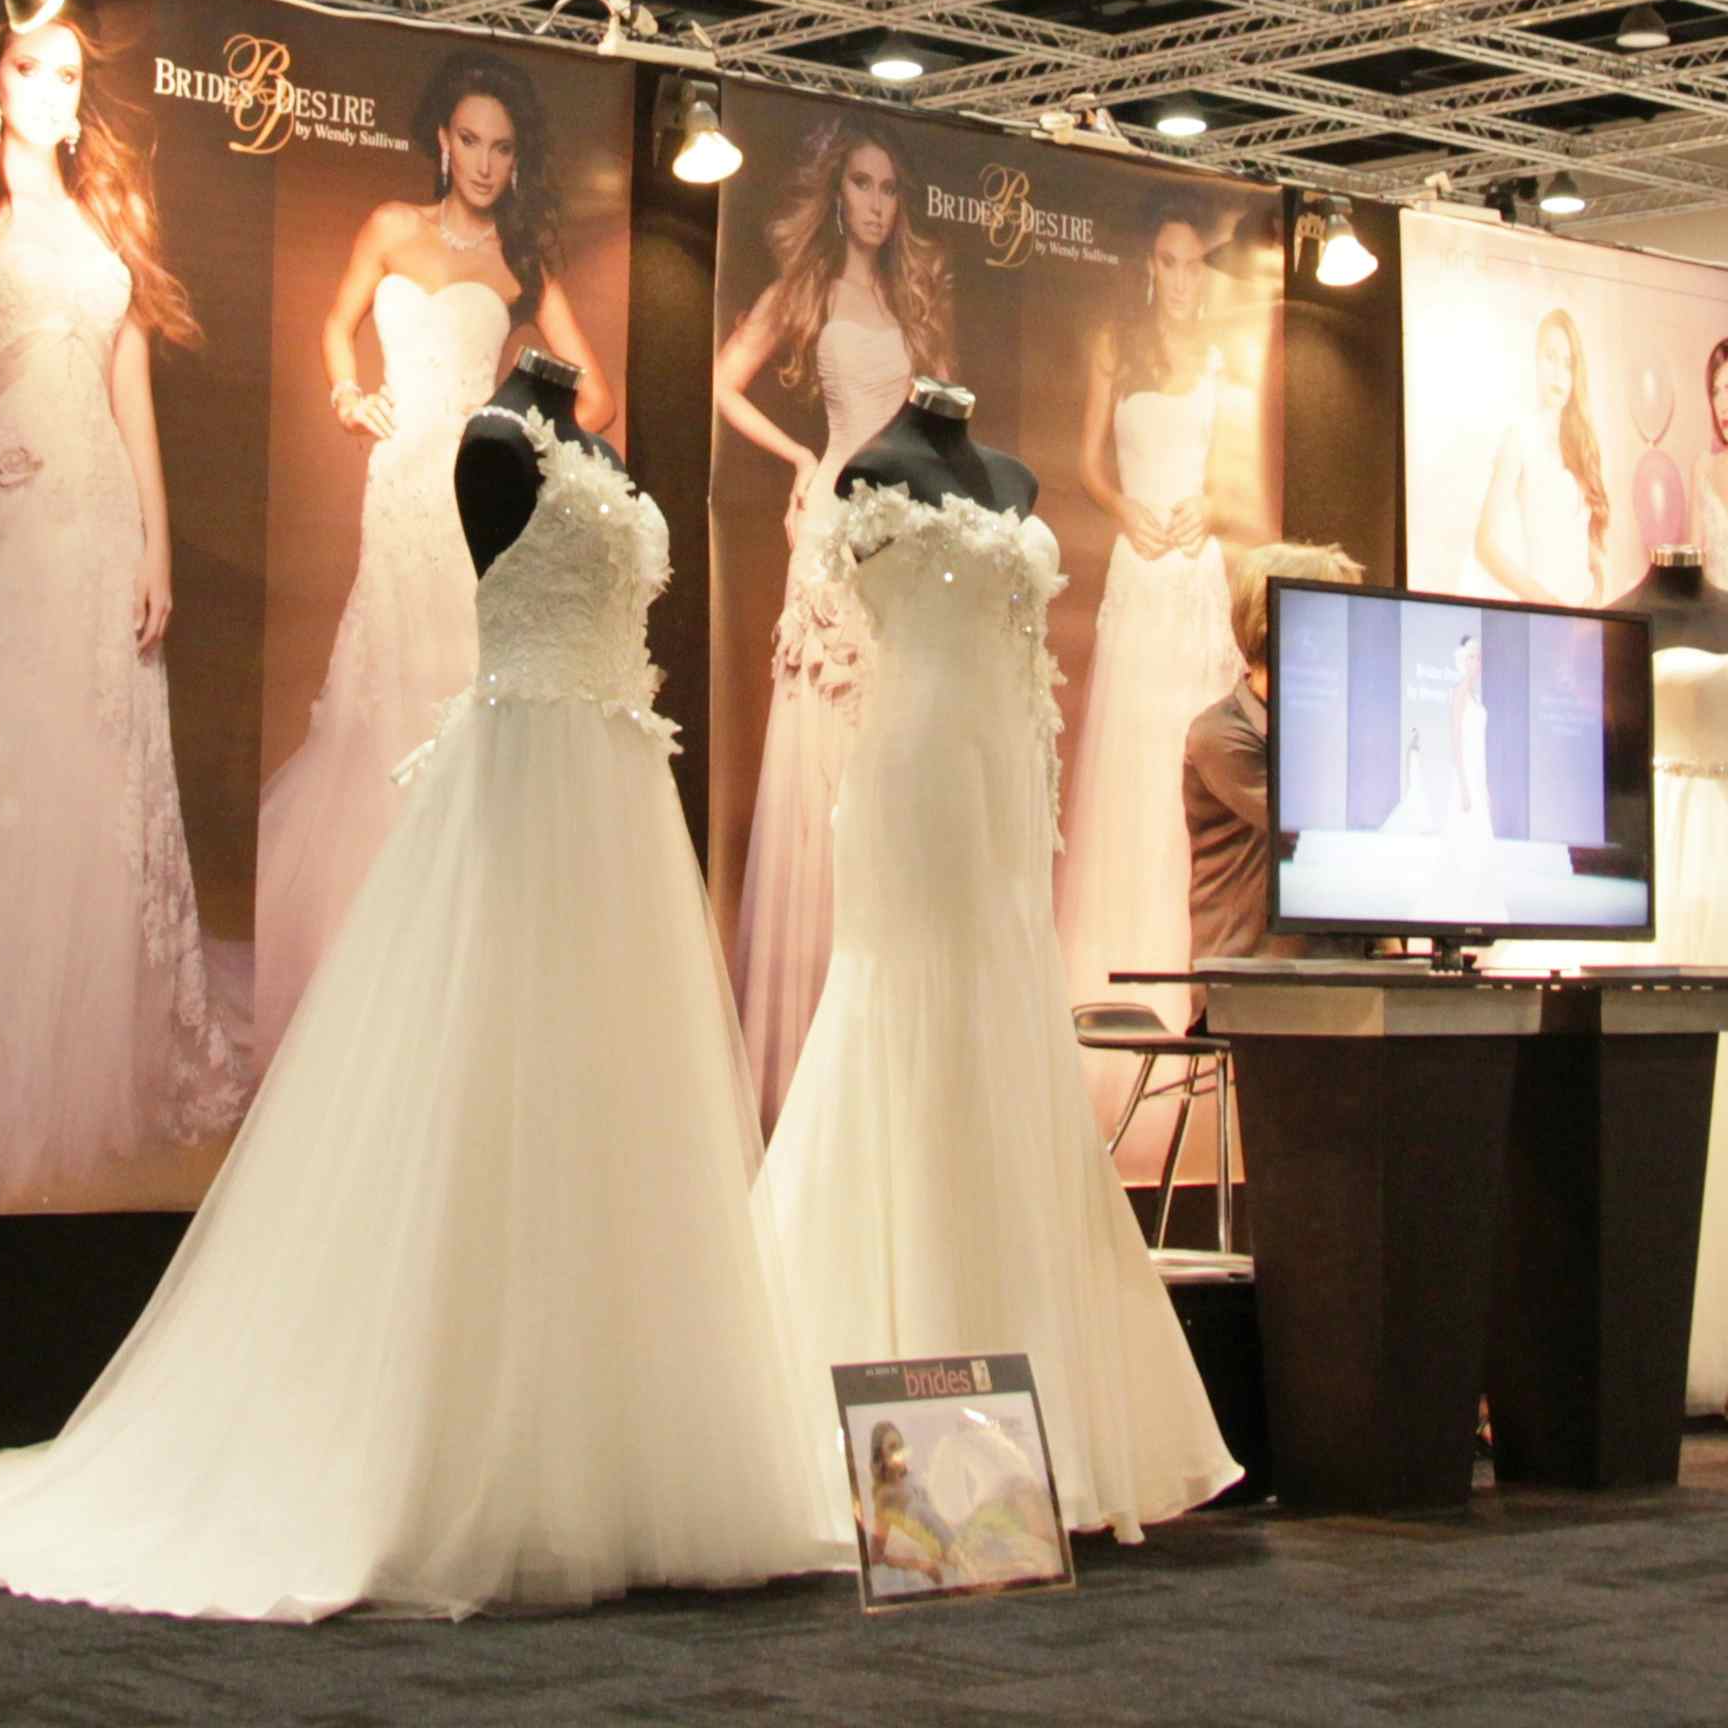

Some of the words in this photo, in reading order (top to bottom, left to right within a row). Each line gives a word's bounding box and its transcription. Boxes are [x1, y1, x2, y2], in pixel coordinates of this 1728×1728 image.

[295, 121, 310, 141] by
[315, 123, 356, 146] Wendy
[359, 129, 409, 152] Sullivan
[902, 1361, 972, 1397] brides
